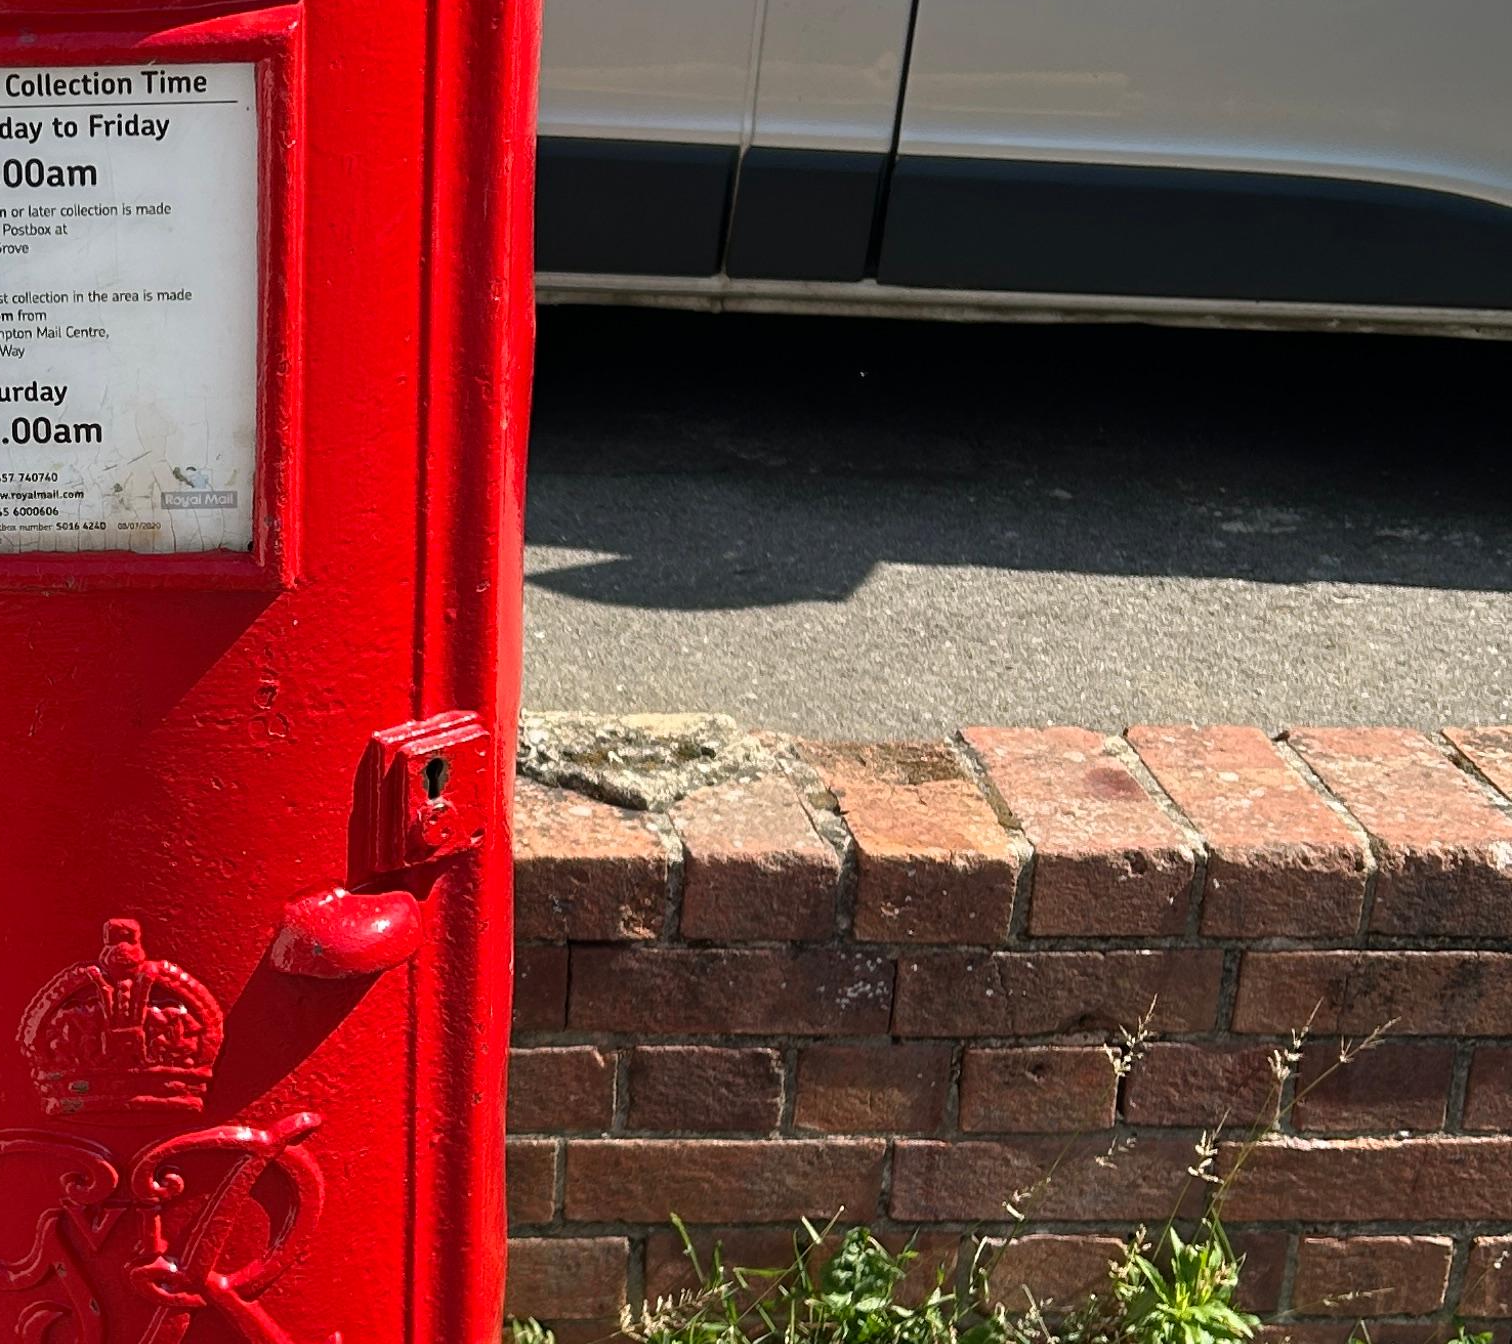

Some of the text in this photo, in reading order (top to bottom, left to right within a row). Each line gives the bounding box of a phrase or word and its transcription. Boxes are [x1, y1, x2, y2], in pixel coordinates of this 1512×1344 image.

[5, 70, 133, 98] Collection
[139, 69, 207, 95] Time
[51, 117, 78, 139] to
[89, 112, 170, 142] Friday
[10, 207, 25, 219] or
[28, 204, 57, 218] later
[60, 203, 118, 217] collection
[121, 202, 132, 216] is
[135, 201, 172, 216] made
[2, 223, 52, 237] Postbox
[54, 223, 69, 236] at
[11, 291, 69, 305] collection
[72, 290, 84, 303] in
[87, 289, 109, 303] the
[111, 292, 139, 303] area
[143, 289, 154, 302] is
[156, 288, 193, 302] made
[17, 308, 47, 322] from
[36, 326, 62, 339] Mail
[65, 325, 110, 339] Centre,
[18, 472, 58, 483] 740740
[165, 492, 234, 509] Royal Mail
[12, 506, 60, 517] 6000606
[19, 523, 53, 532] number
